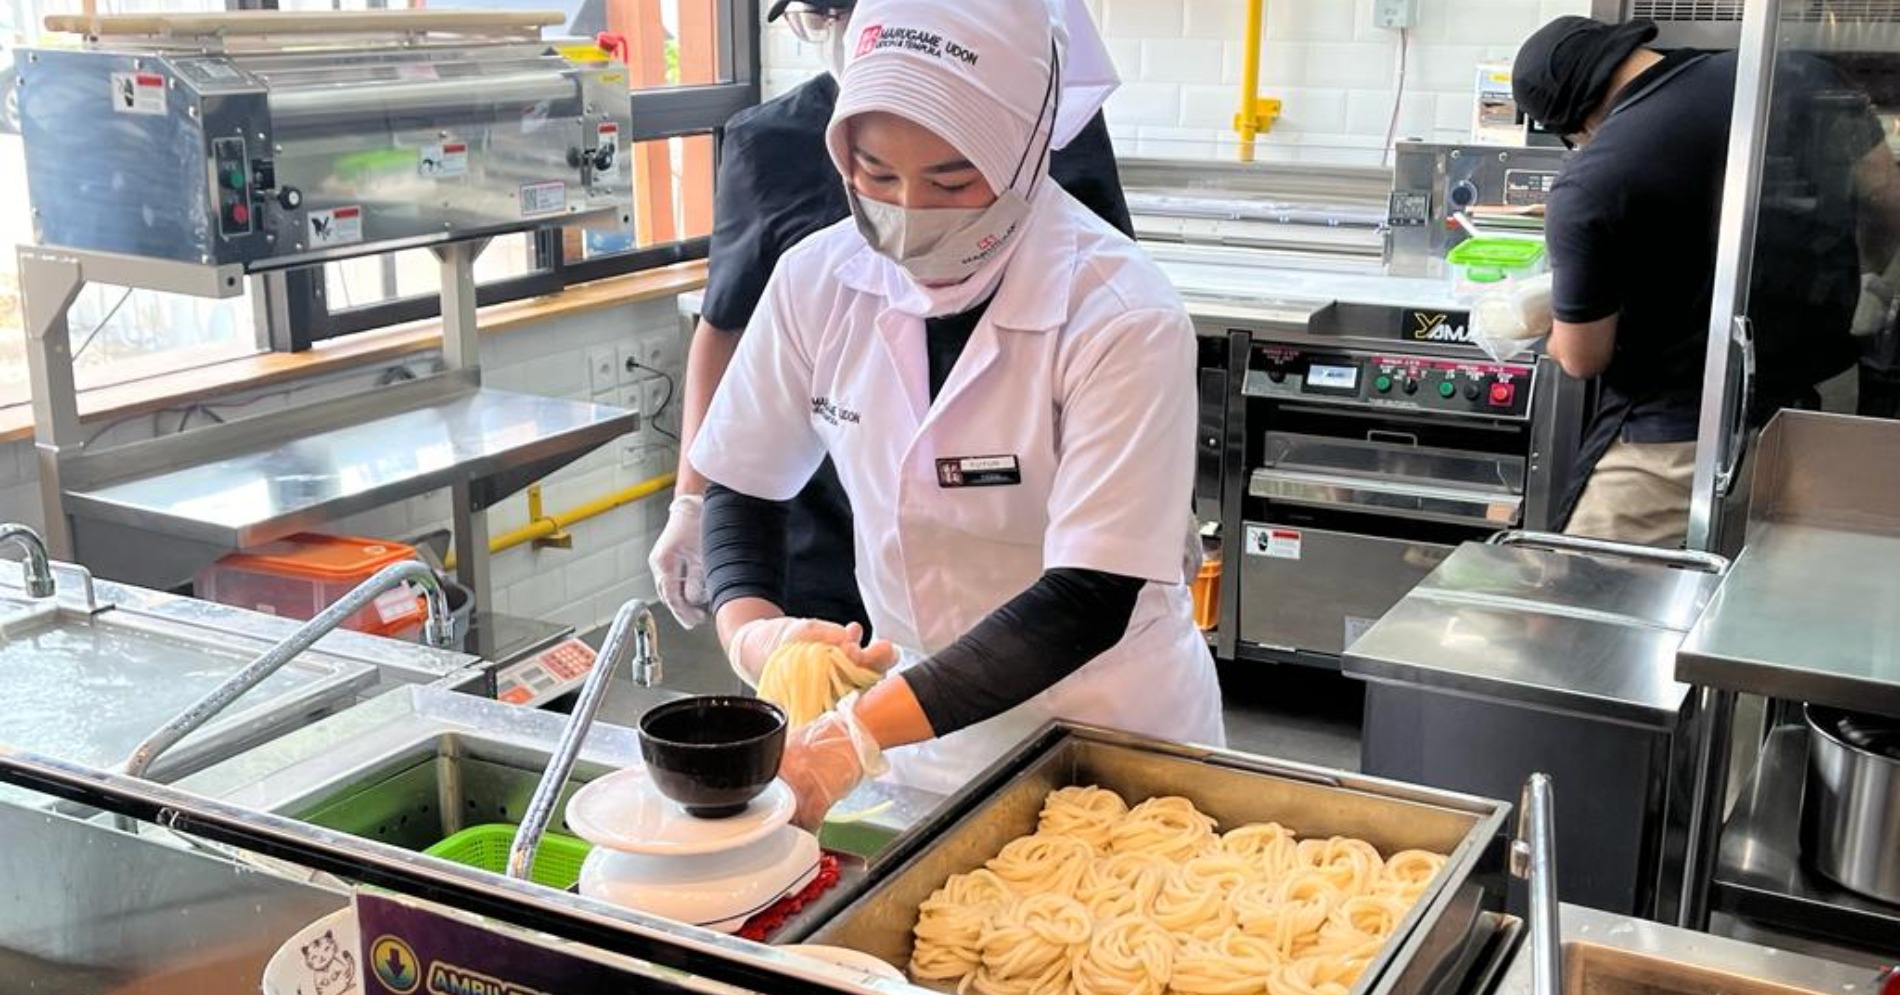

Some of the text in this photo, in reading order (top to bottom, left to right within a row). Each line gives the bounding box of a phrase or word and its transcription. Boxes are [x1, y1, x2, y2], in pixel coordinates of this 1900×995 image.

[880, 26, 943, 47] MARUGAME
[945, 40, 979, 65] UDON
[904, 40, 942, 58] TEMPURA
